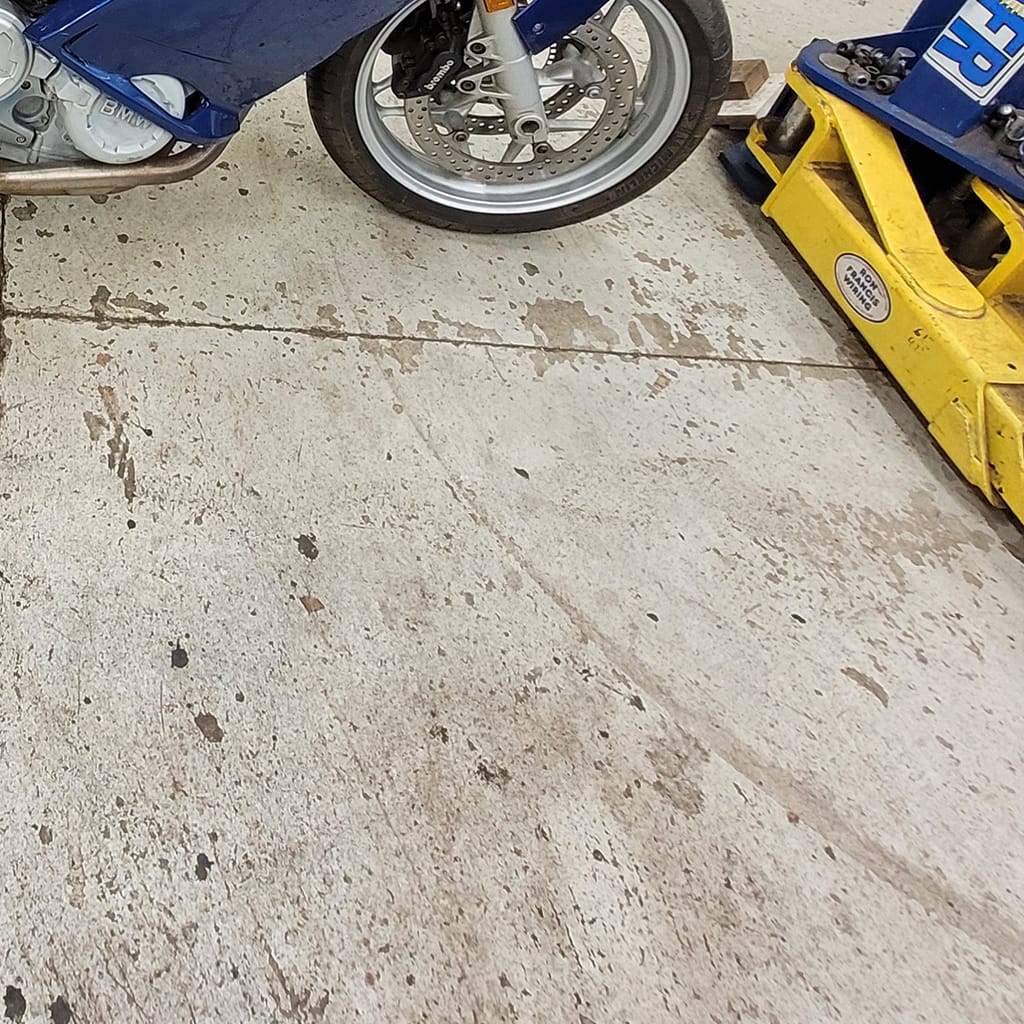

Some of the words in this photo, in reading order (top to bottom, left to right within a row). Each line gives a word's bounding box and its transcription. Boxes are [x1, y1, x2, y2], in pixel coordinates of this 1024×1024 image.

[423, 59, 455, 90] brembo
[100, 98, 152, 129] BMW
[844, 274, 872, 311] WIRING
[846, 265, 880, 307] FRANCIS
[860, 268, 878, 290] RON
